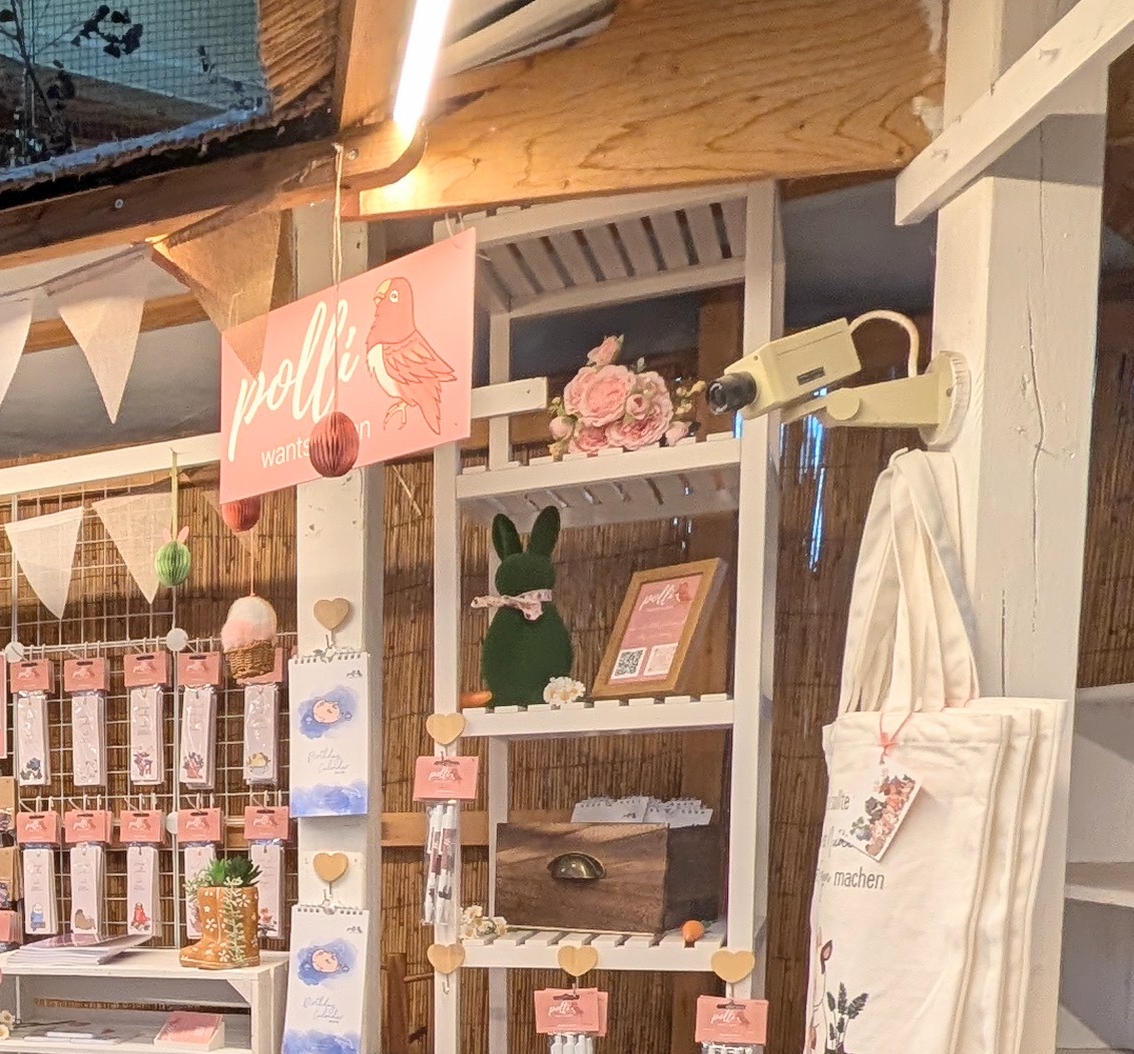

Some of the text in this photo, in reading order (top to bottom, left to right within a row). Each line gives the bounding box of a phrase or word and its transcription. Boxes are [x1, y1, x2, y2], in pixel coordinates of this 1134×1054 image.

[228, 298, 360, 462] polli
[261, 436, 311, 469] wants
[833, 866, 885, 890] machen
